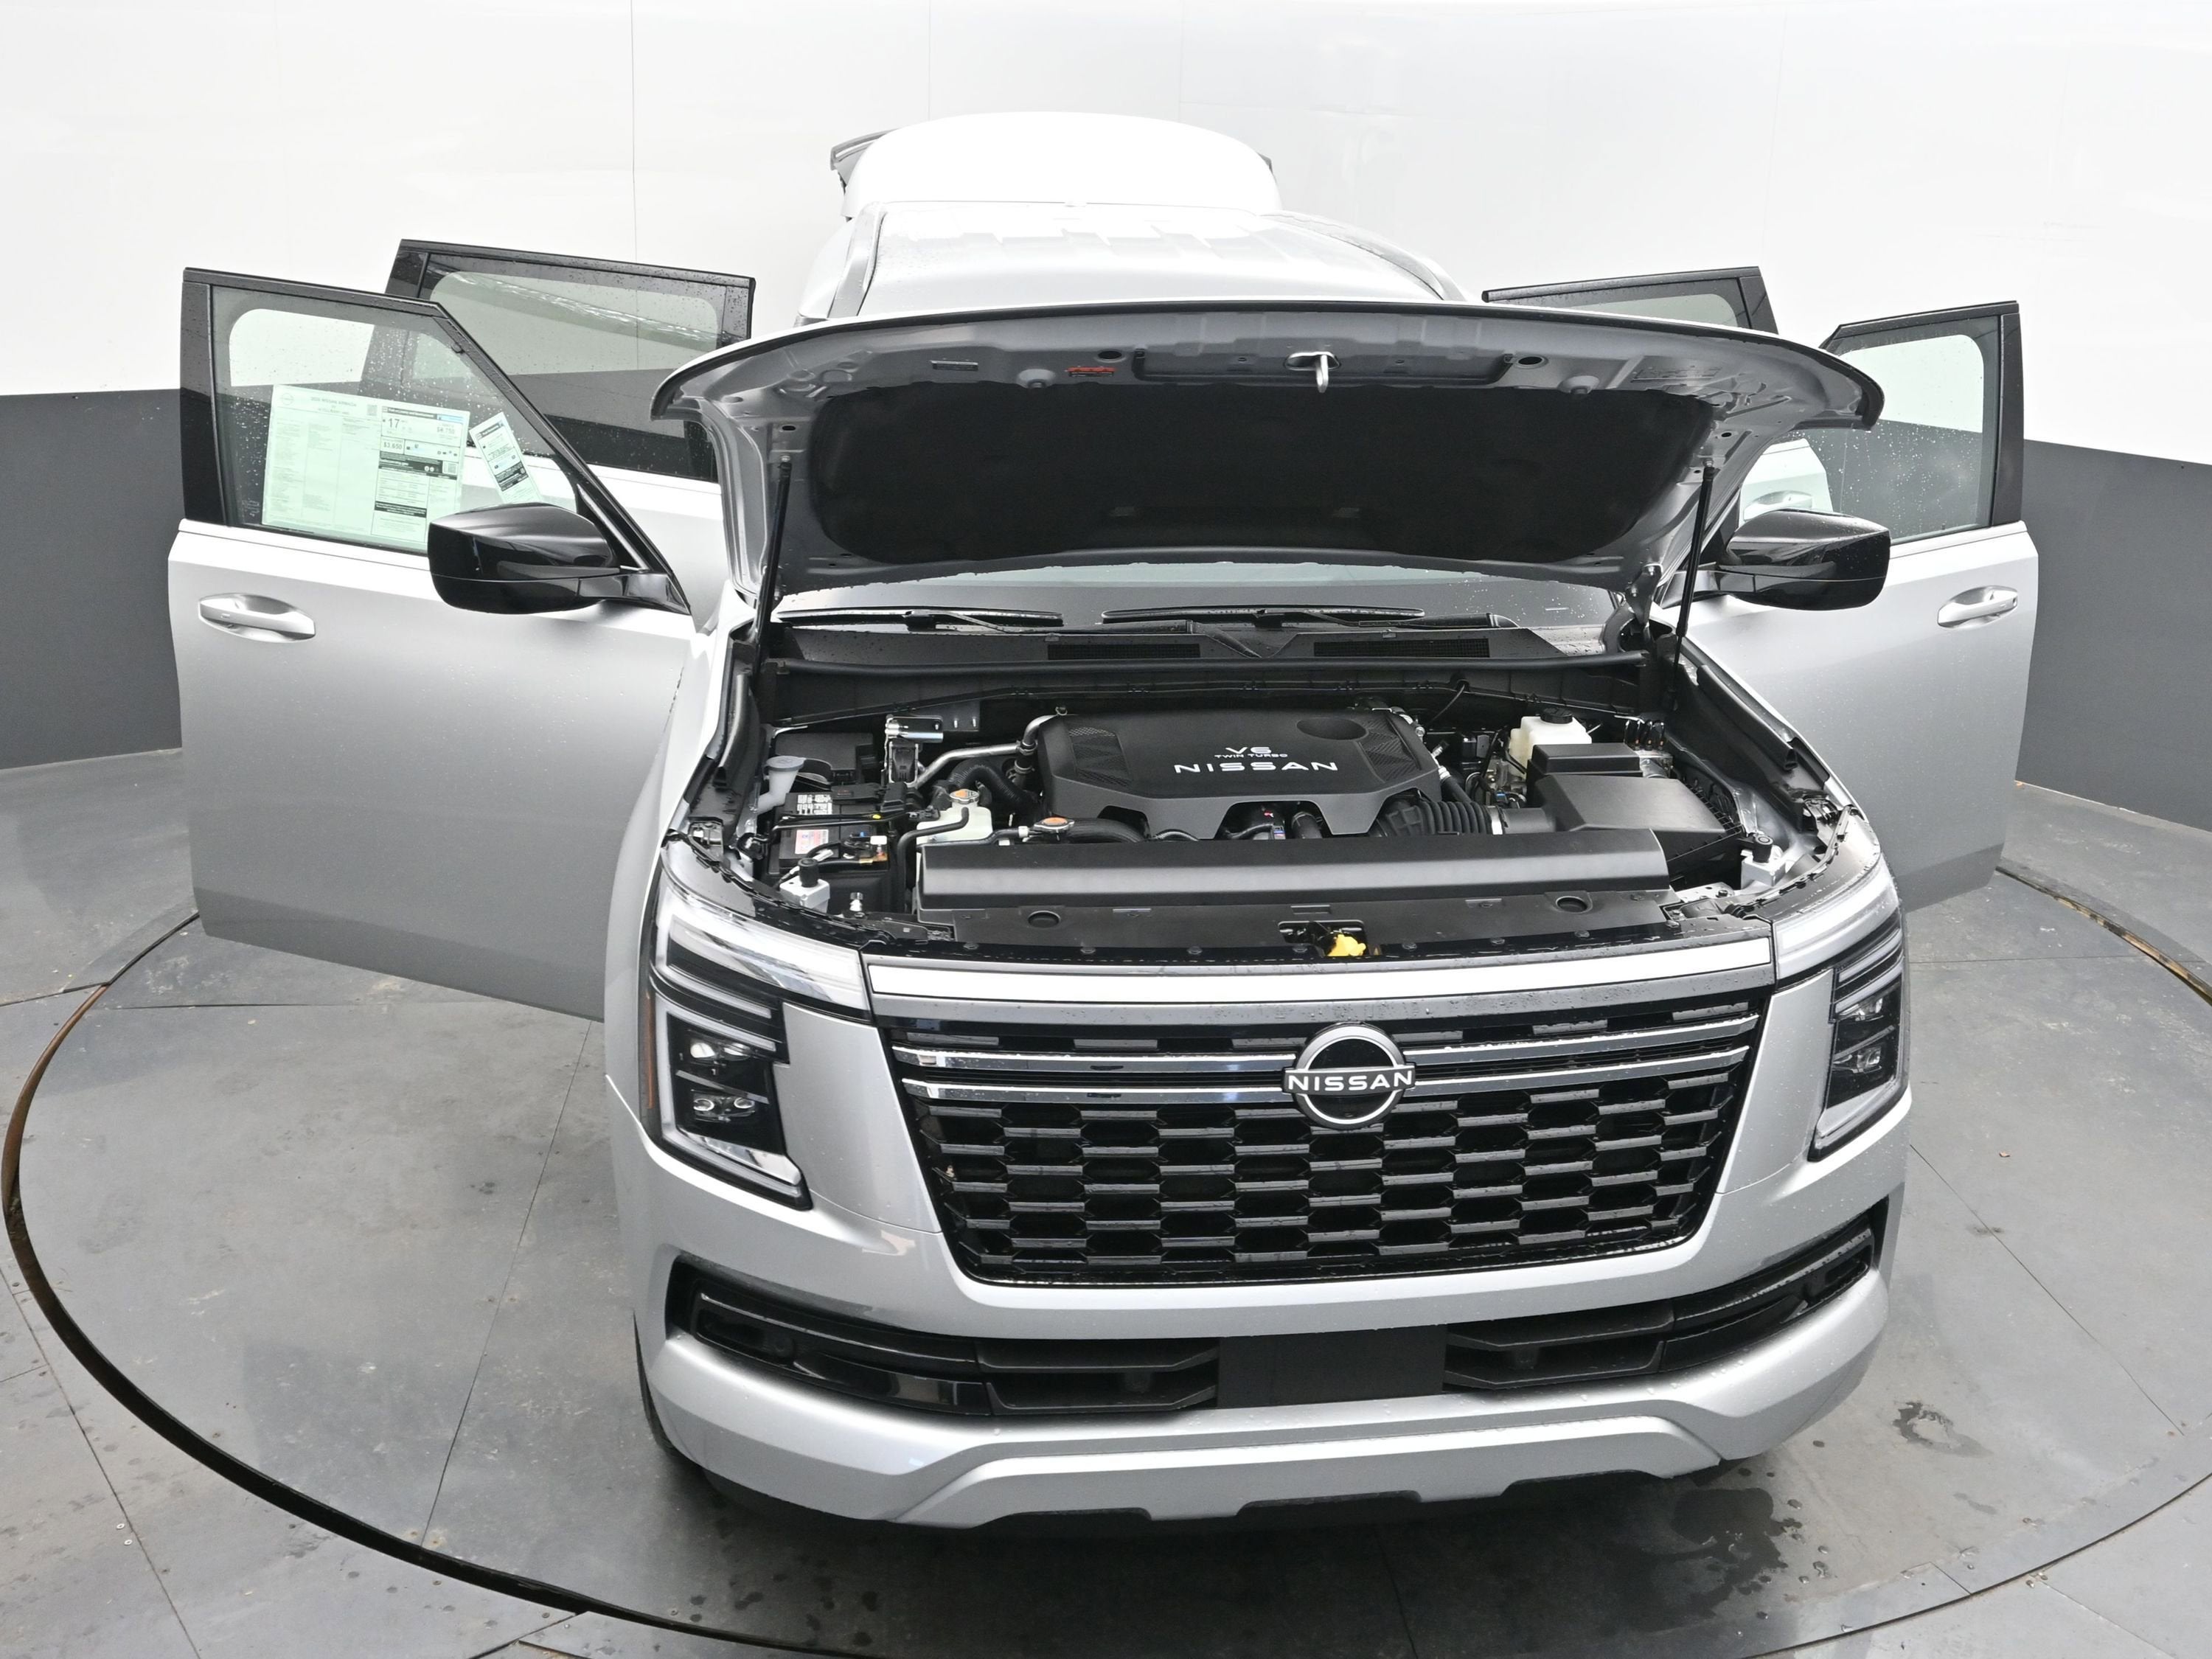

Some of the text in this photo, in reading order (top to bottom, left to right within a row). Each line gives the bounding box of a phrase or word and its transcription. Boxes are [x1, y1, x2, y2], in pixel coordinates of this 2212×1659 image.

[388, 418, 400, 428] 17
[1225, 746, 1272, 754] V6
[1174, 761, 1338, 773] NISSAN
[1288, 1070, 1413, 1091] NISSAN
